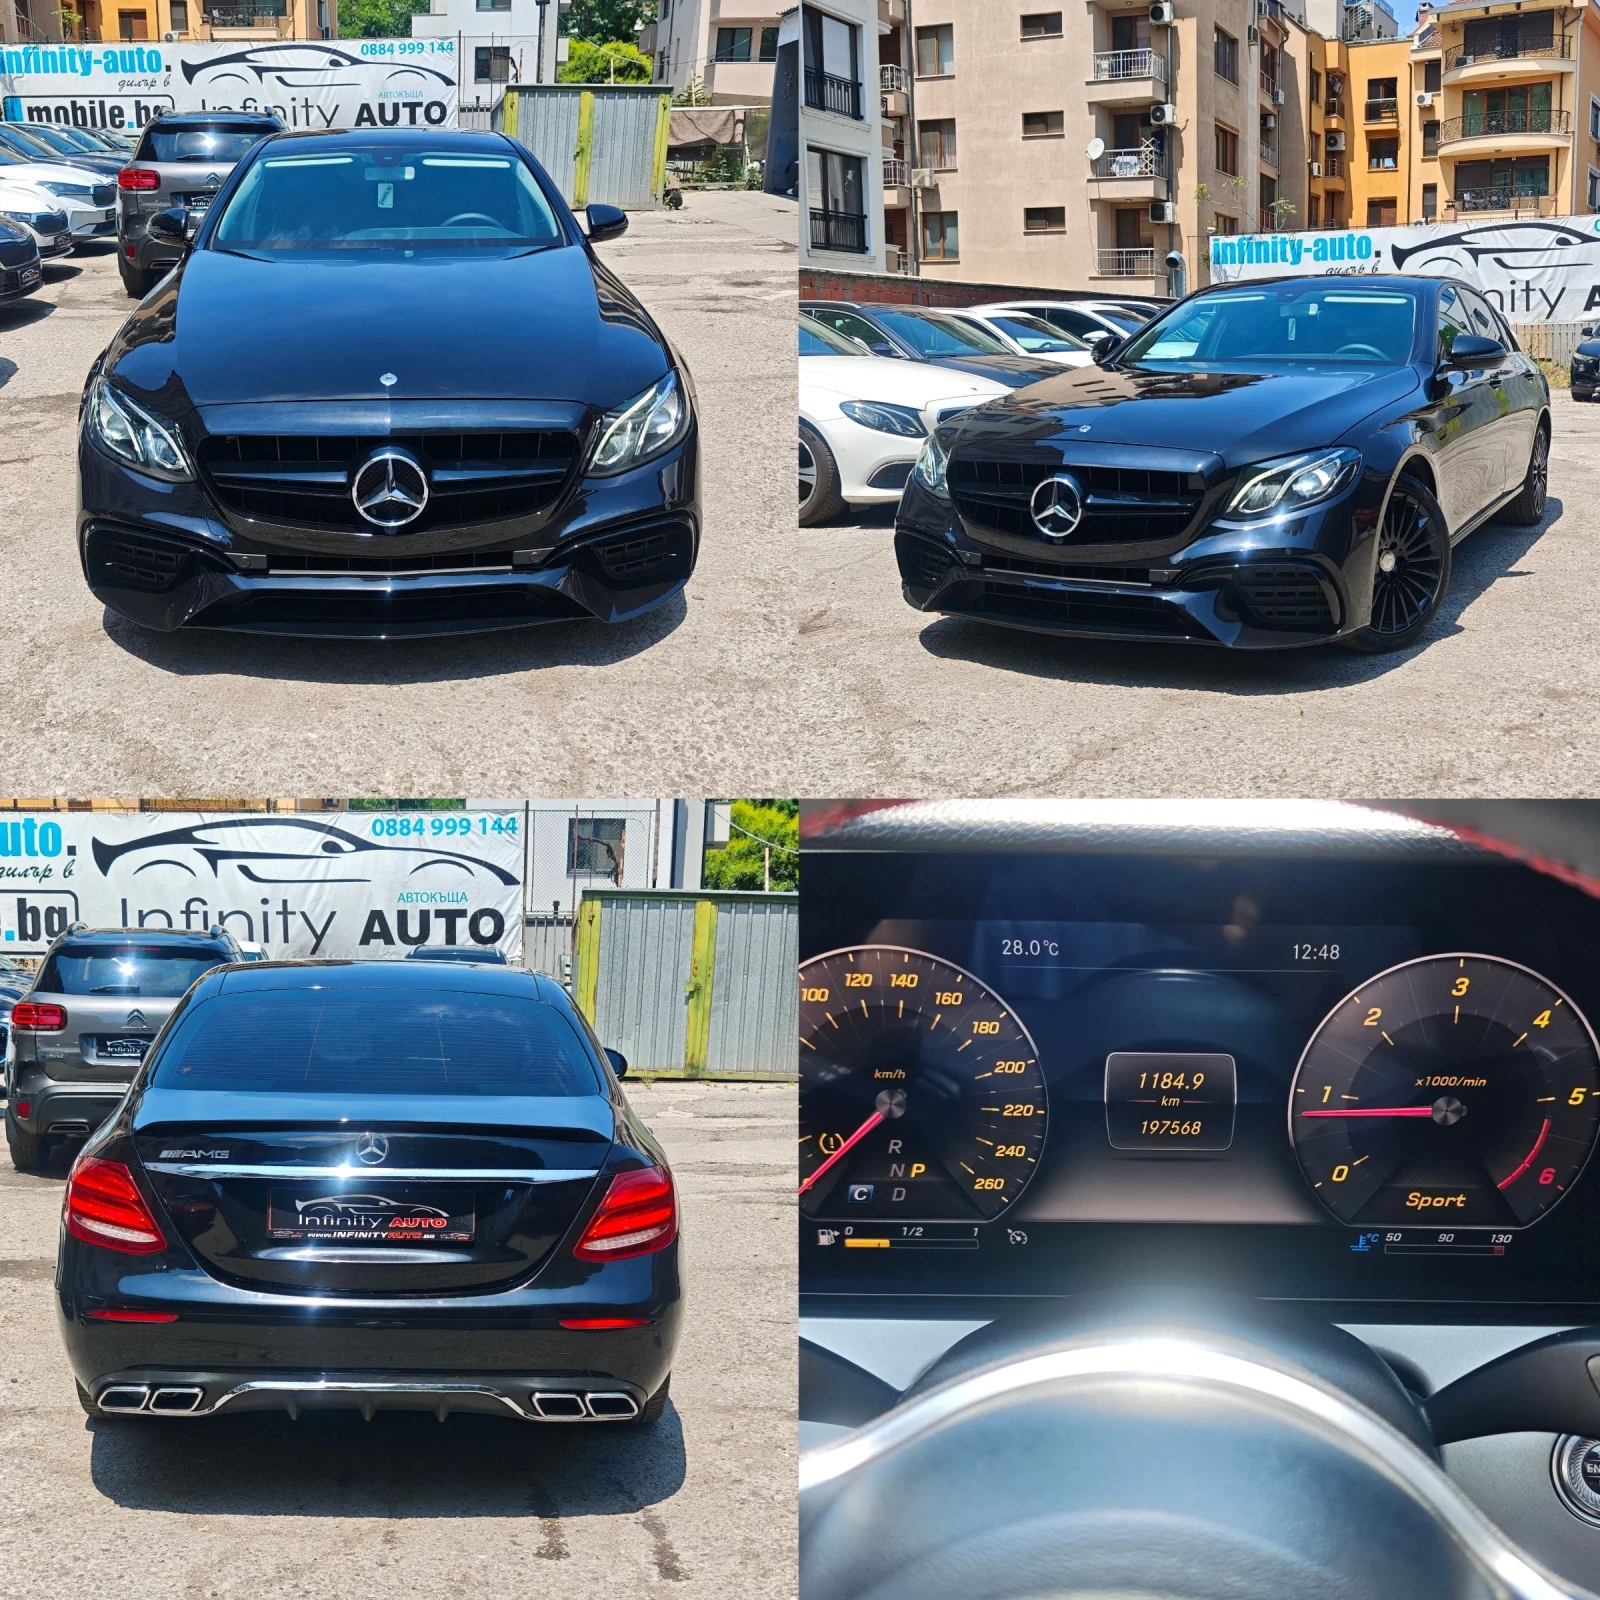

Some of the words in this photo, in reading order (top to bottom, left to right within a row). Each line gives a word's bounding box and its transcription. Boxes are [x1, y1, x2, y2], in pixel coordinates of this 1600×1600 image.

[361, 43, 395, 56] 0884
[399, 42, 425, 54] 999
[429, 41, 454, 53] 144
[378, 90, 424, 99] АВТОКЪЩА
[27, 100, 164, 129] mobile.b
[354, 101, 447, 127] AUTO
[372, 818, 425, 837] 0884
[431, 818, 472, 836] 999
[479, 817, 518, 835] 144
[397, 892, 468, 904] АВТОКЪЩА
[121, 897, 337, 955] Infinity
[359, 908, 505, 946] AUTO
[1293, 945, 1340, 960] 12:48
[845, 974, 873, 987] 120
[890, 974, 919, 987] 140
[1452, 978, 1469, 996] 3
[801, 988, 829, 1002] 100
[935, 992, 963, 1005] 160
[1363, 1008, 1382, 1026] 2
[1533, 1010, 1551, 1028] 4
[972, 1022, 1000, 1034] 180
[874, 1069, 906, 1080] km/h
[994, 1062, 1026, 1074] 200
[1139, 1073, 1205, 1090] 1184.9
[1414, 1076, 1487, 1088] x1000/min
[1161, 1095, 1180, 1108] km
[1322, 1087, 1332, 1103] 1
[1568, 1088, 1586, 1105] 5
[1003, 1105, 1034, 1117] 220
[1141, 1120, 1202, 1136] 197568
[889, 1141, 902, 1153] R
[995, 1146, 1026, 1158] 240
[890, 1164, 905, 1177] N
[911, 1164, 925, 1177] P
[1332, 1166, 1349, 1182] 0
[1539, 1168, 1555, 1185] 6
[974, 1178, 1005, 1191] 260
[854, 1188, 868, 1201] C
[892, 1188, 906, 1201] D
[1406, 1193, 1466, 1210] Sport
[299, 1214, 382, 1228] Infinity
[389, 1217, 447, 1228] AUTO
[845, 1227, 854, 1236] 0
[902, 1227, 923, 1237] 1/2
[973, 1228, 979, 1237] 1
[1385, 1232, 1402, 1242] 50
[1438, 1233, 1454, 1244] 90
[1491, 1234, 1512, 1244] 130
